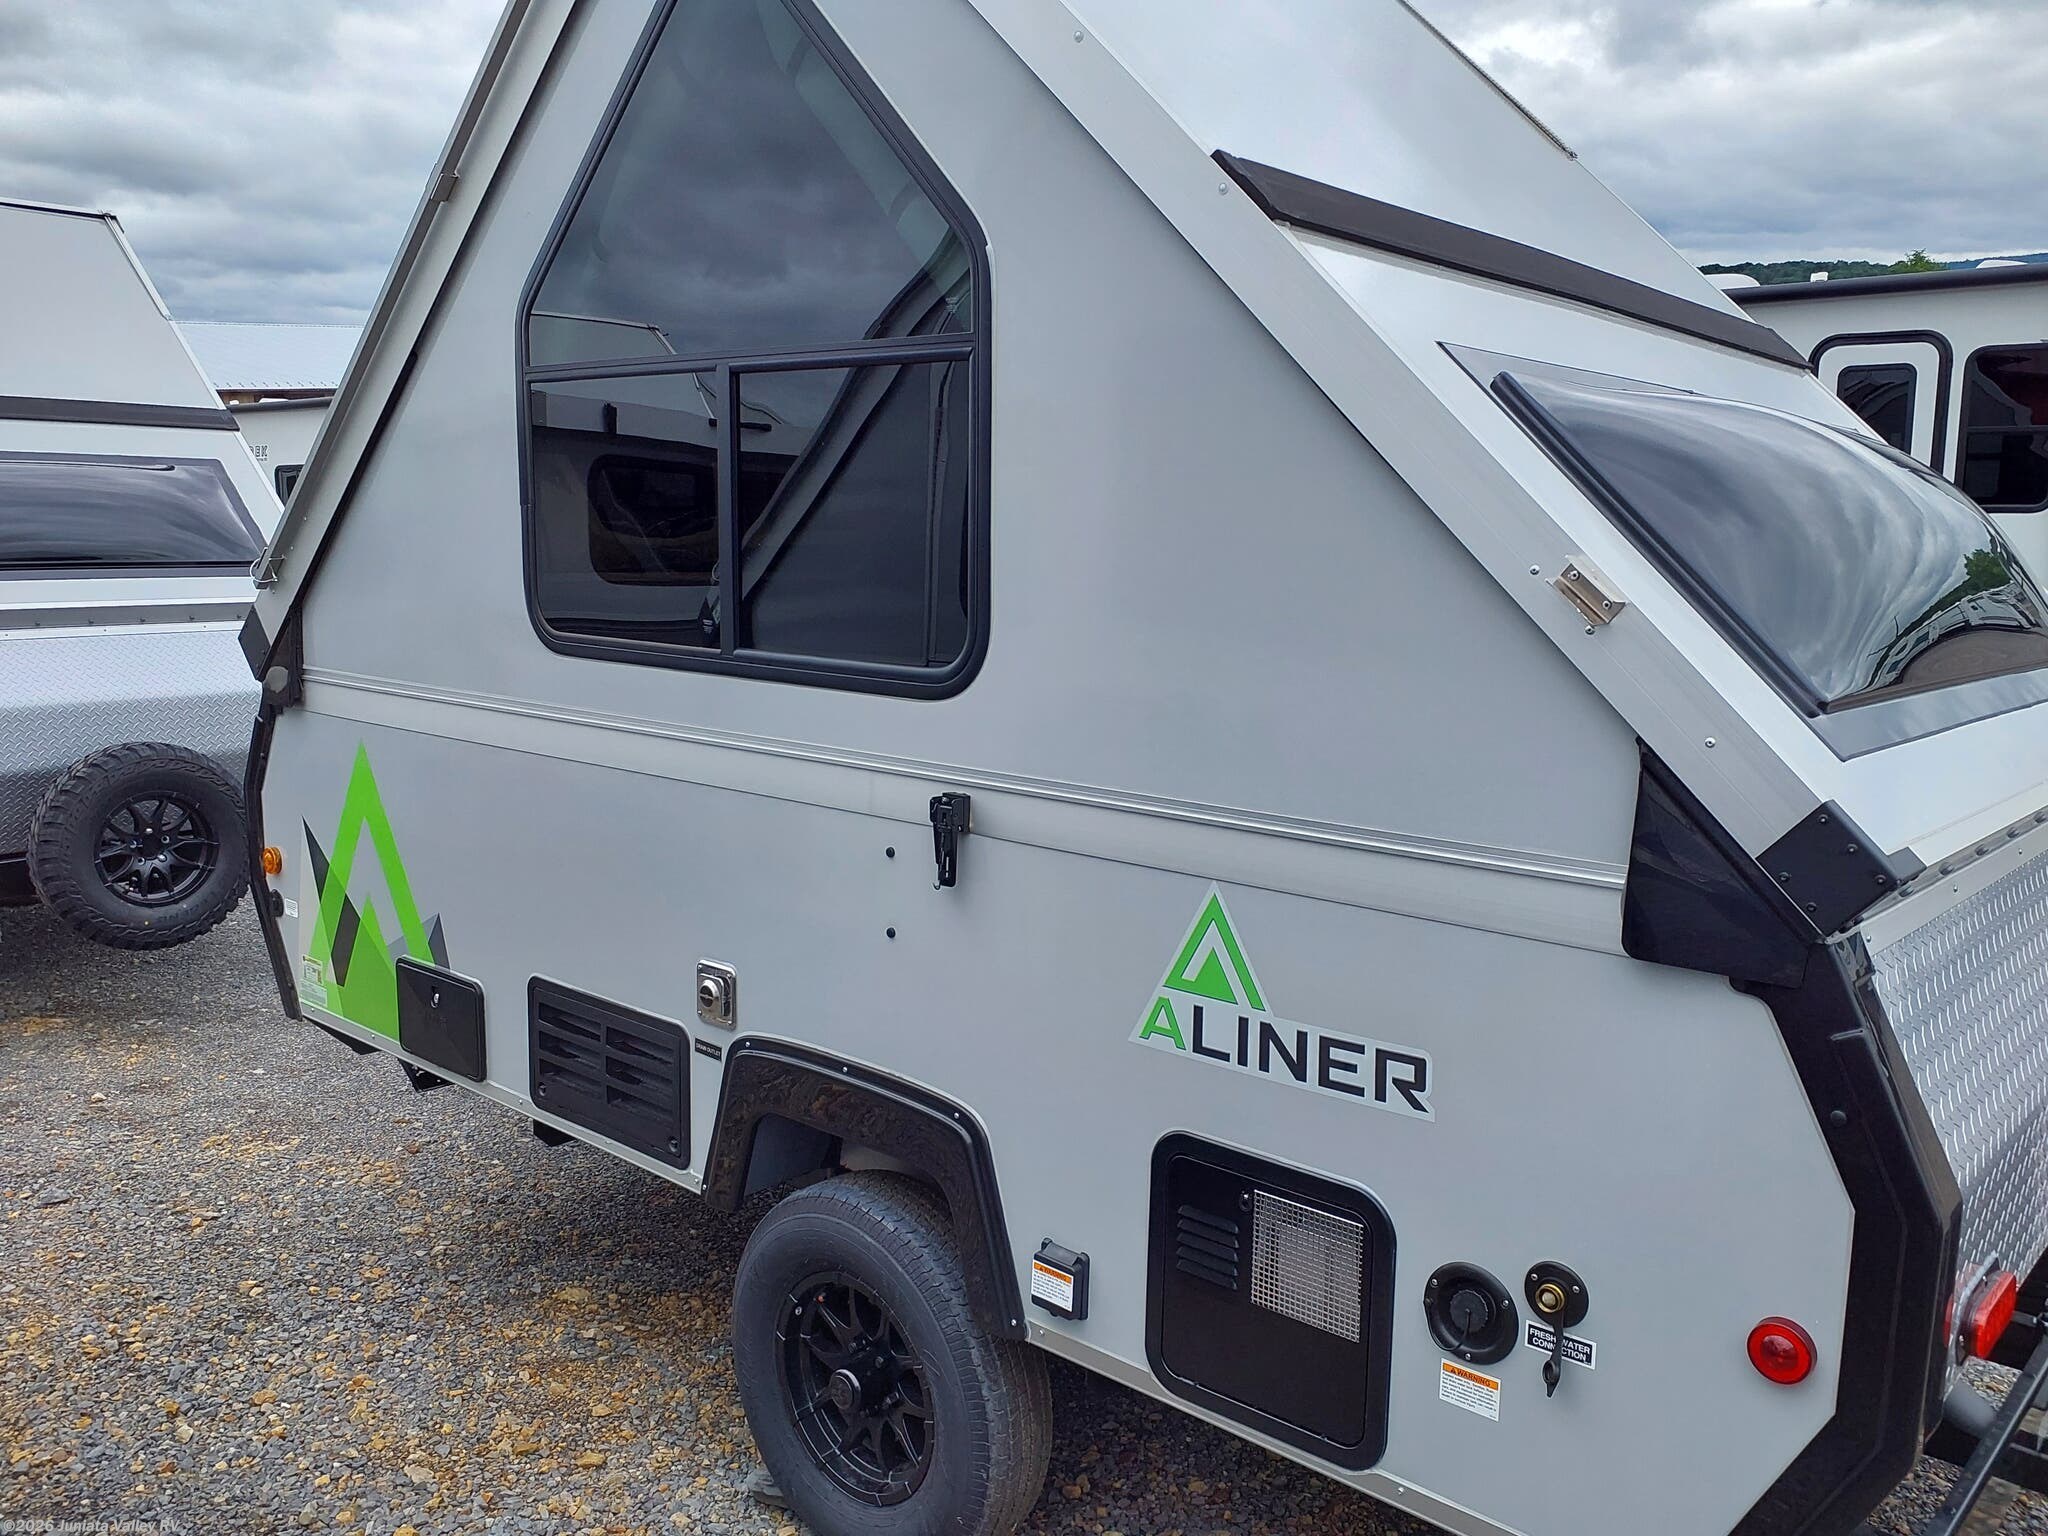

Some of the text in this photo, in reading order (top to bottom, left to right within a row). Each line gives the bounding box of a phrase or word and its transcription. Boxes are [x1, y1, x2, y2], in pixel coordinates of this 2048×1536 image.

[1139, 995, 1430, 1114] ALINER
[1529, 1327, 1557, 1343] FRESH
[1532, 1337, 1587, 1361] CONNCTION
[1457, 1369, 1491, 1387] WARNING
